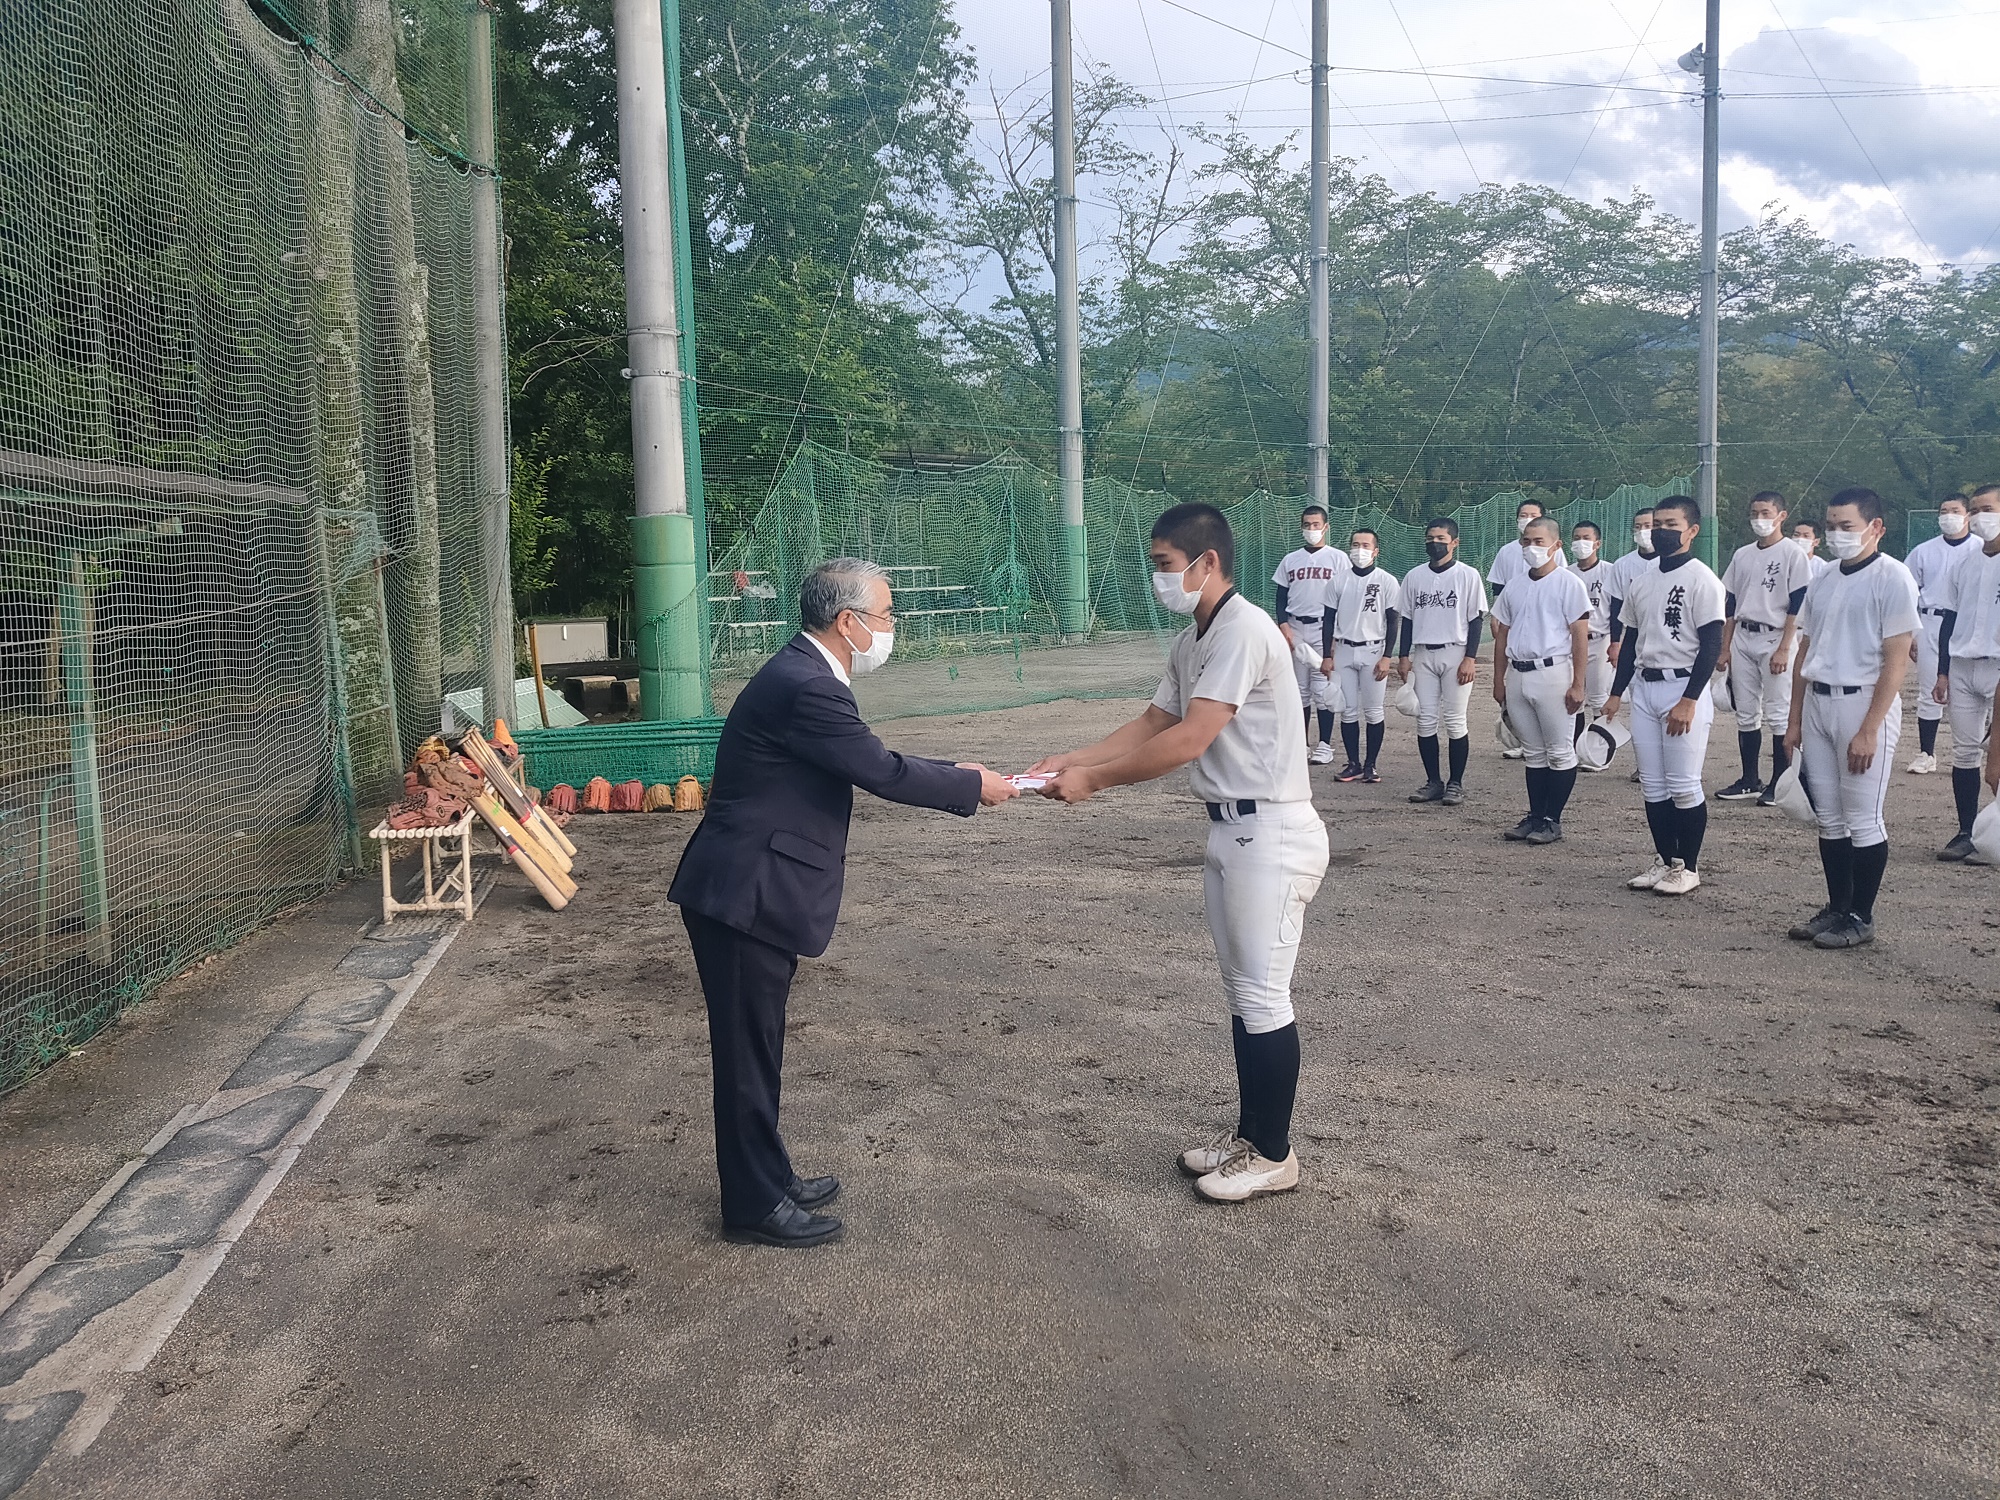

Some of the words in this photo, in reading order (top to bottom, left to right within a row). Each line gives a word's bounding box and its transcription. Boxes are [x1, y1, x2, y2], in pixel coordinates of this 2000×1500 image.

[1761, 560, 1781, 593] 杉崎
[1361, 583, 1381, 613] 野尻
[1590, 579, 1603, 608] 内田
